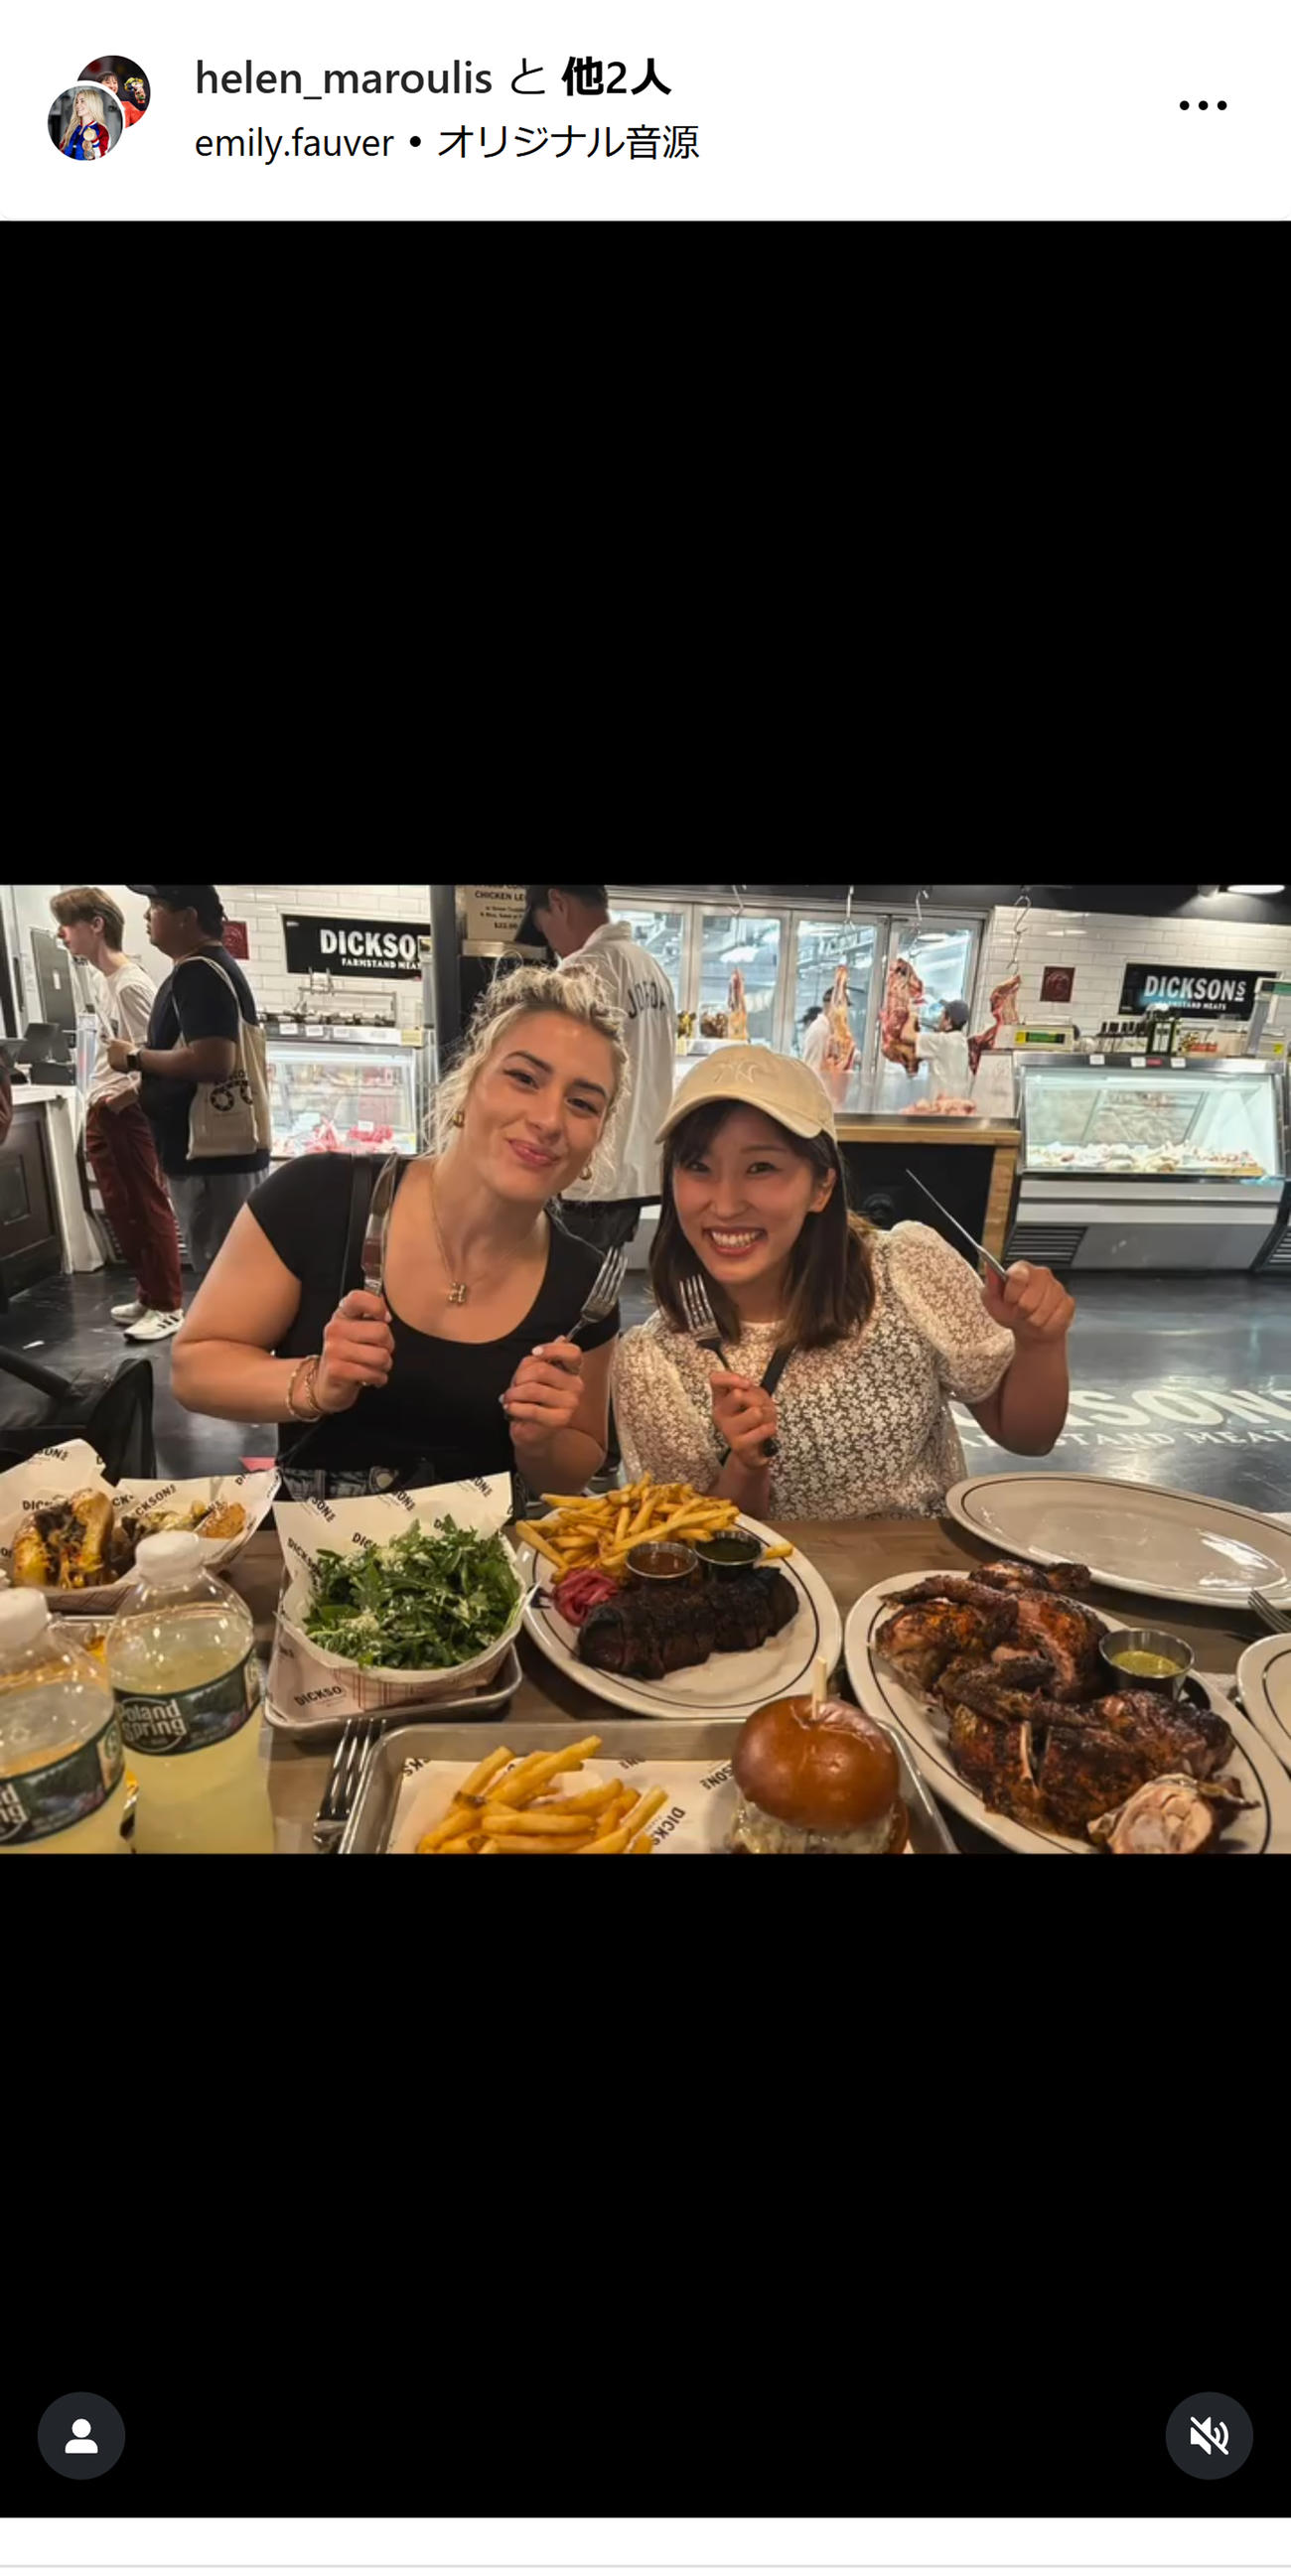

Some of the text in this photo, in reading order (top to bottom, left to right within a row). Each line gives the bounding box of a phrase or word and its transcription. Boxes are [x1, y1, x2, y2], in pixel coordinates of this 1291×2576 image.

[475, 890, 512, 901] CHICKEN
[320, 929, 417, 962] DICKSO
[342, 957, 397, 969] FARMSTAND
[1203, 1002, 1227, 1011] MEATS
[1183, 1429, 1291, 1445] MEAT
[293, 1685, 343, 1707] DICKSO
